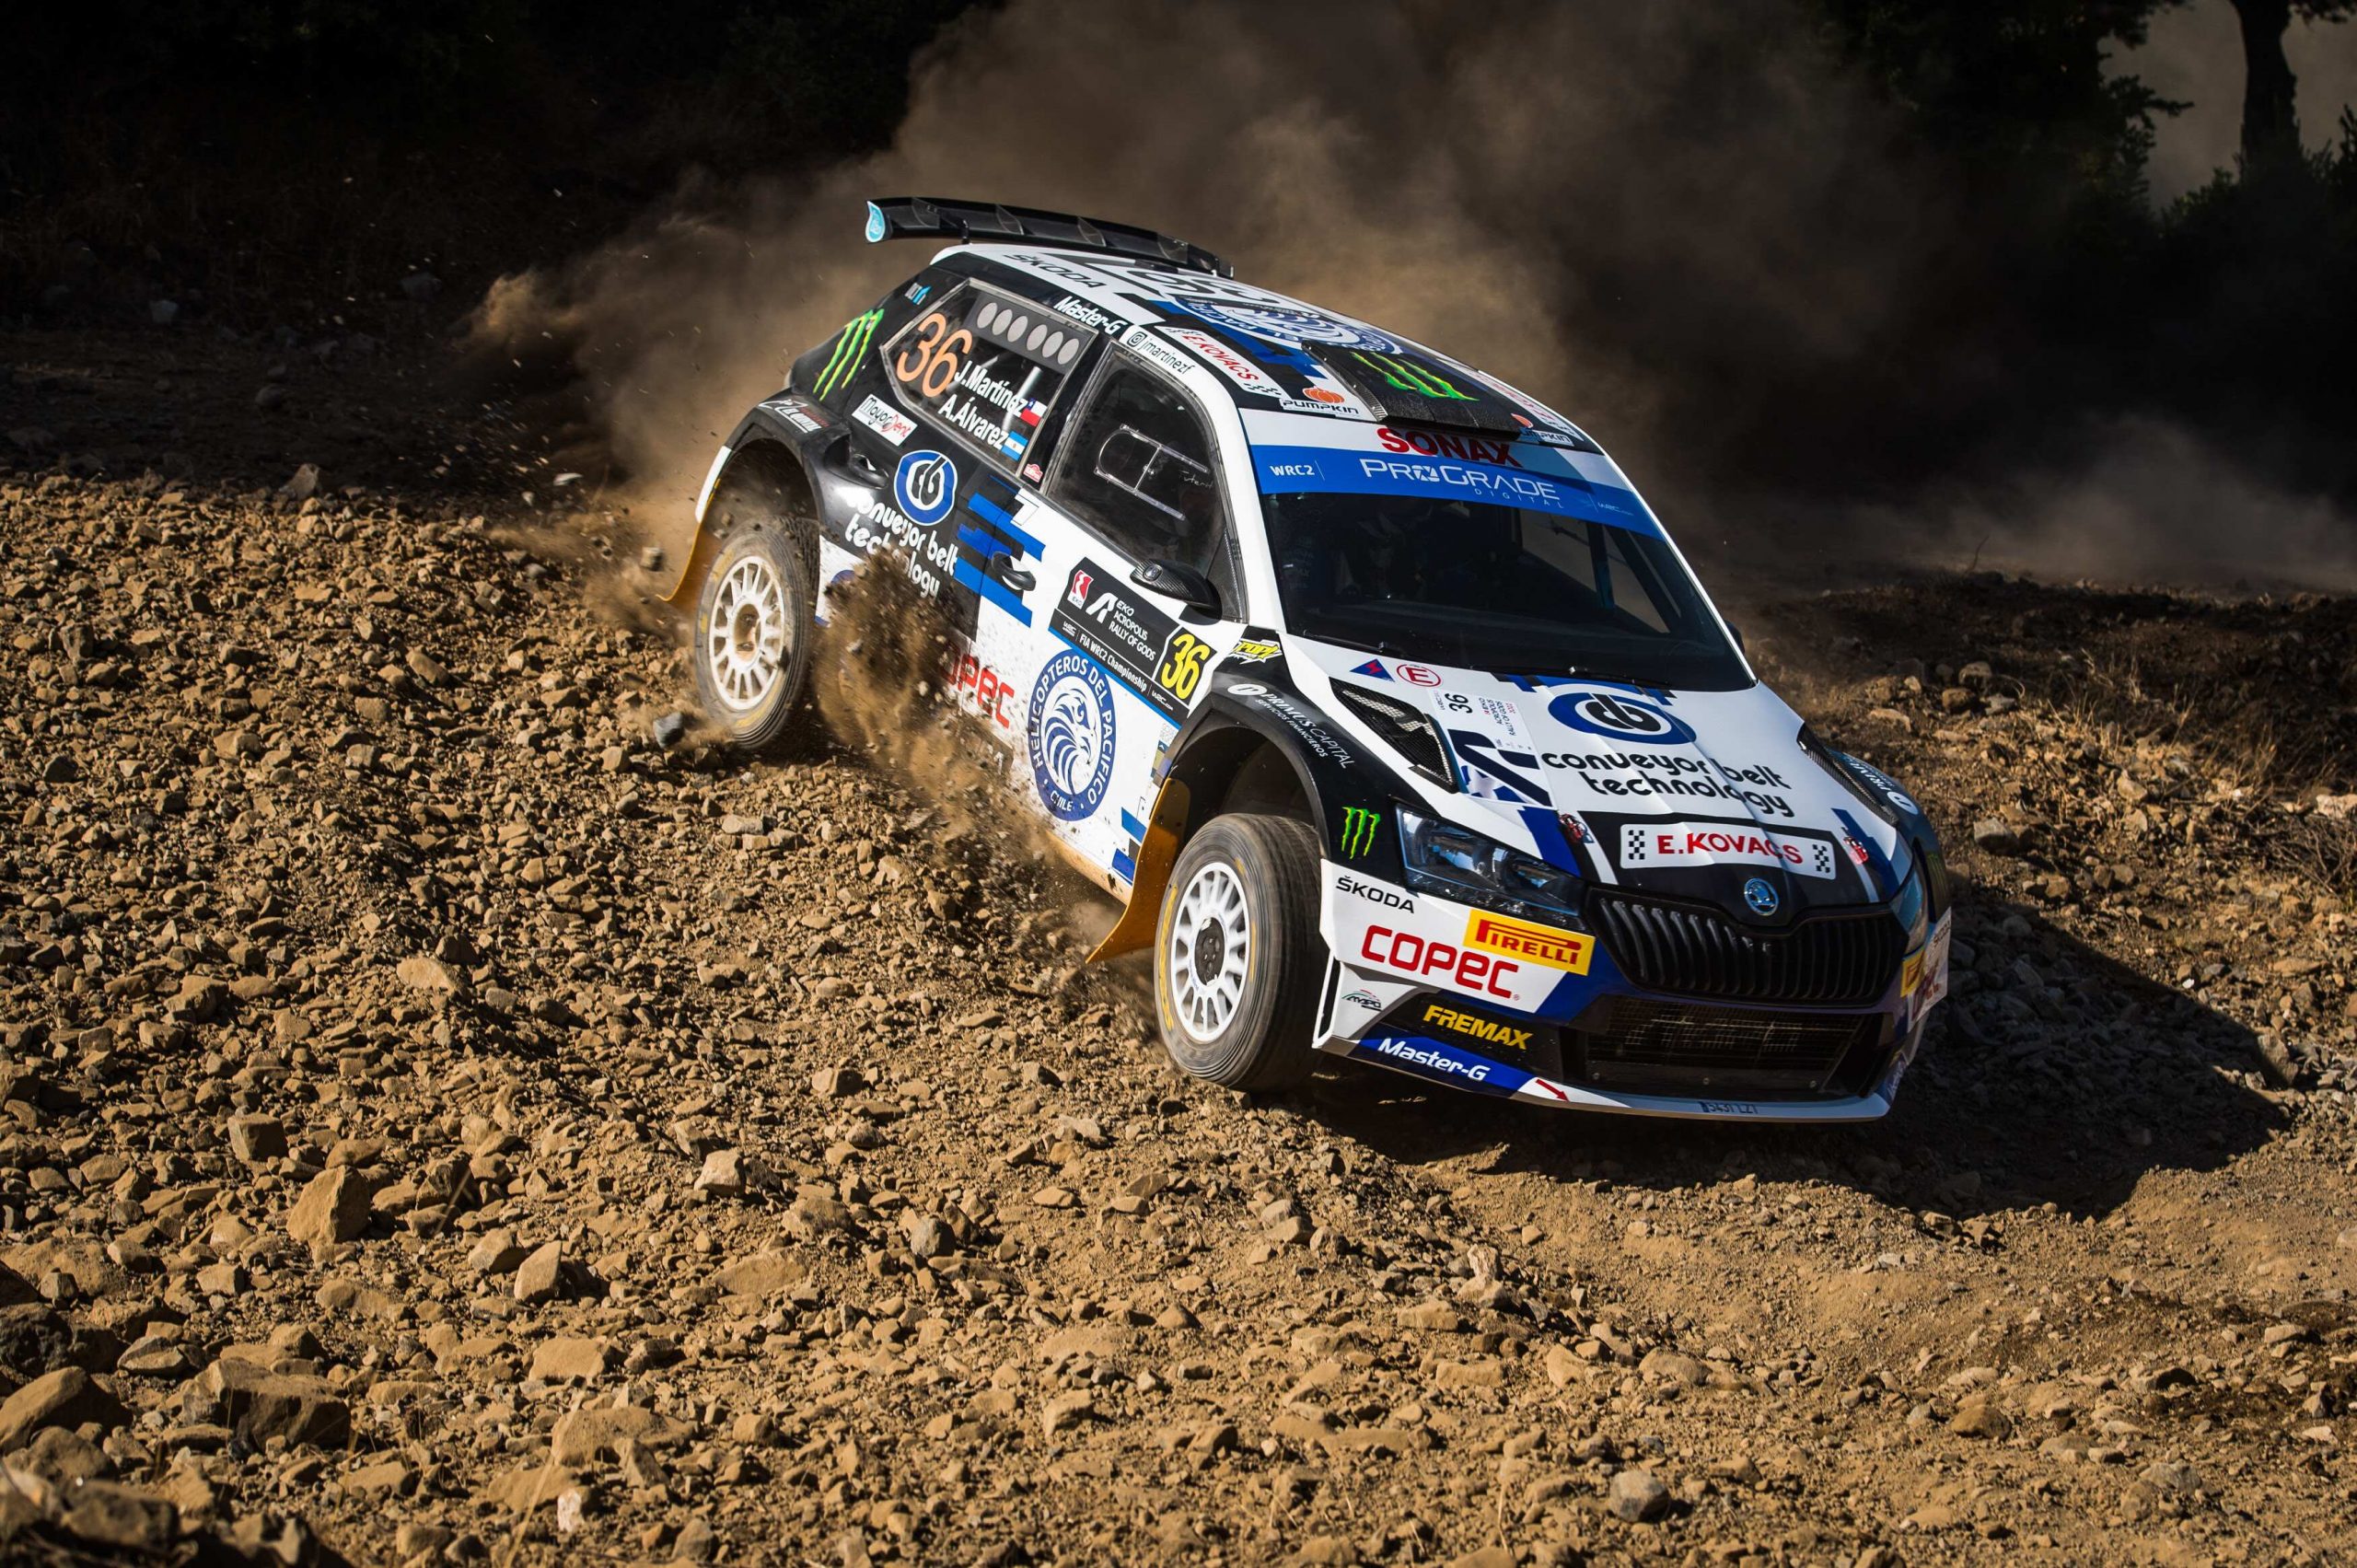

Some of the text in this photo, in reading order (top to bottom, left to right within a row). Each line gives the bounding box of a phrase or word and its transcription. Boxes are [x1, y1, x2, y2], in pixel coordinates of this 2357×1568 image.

[1053, 296, 1129, 335] Master-G
[896, 312, 972, 398] 36
[1138, 338, 1196, 375] jmartinezf
[953, 360, 1028, 418] J.Martínez
[1283, 399, 1359, 414] PUMPKIN
[937, 393, 1010, 450] A.Álvarez
[1376, 428, 1523, 468] SONAX
[1270, 464, 1316, 477] WRC2
[1359, 459, 1561, 501] PROGRADE
[1474, 489, 1564, 509] DIGITAL
[845, 490, 958, 576] nveyor belt
[1113, 610, 1148, 641] ACROPOLIS
[1116, 600, 1134, 617] EKO
[1109, 621, 1156, 661] RALLY OF GODS
[1079, 633, 1090, 648] FIA
[1090, 641, 1108, 662] WRC2
[1107, 655, 1148, 692] Championship
[1160, 633, 1211, 700] 36
[1088, 665, 1107, 706] DEL
[1444, 692, 1473, 714] 36
[1030, 656, 1089, 768] HELICOPTEROS
[1260, 693, 1355, 769] PRIMUS CAPITAL
[1087, 710, 1112, 806] PACIFICO
[1287, 720, 1329, 758] FINANCIEROS
[1711, 758, 1792, 790] belt
[1050, 790, 1074, 811] CHILE
[1579, 771, 1795, 818] technology
[1656, 831, 1804, 865] E.KOVACS
[1335, 875, 1415, 914] ŠKODA
[1475, 918, 1582, 965] PIRELLI
[1422, 1005, 1534, 1050] FREMAX
[1377, 1038, 1491, 1082] Master-G
